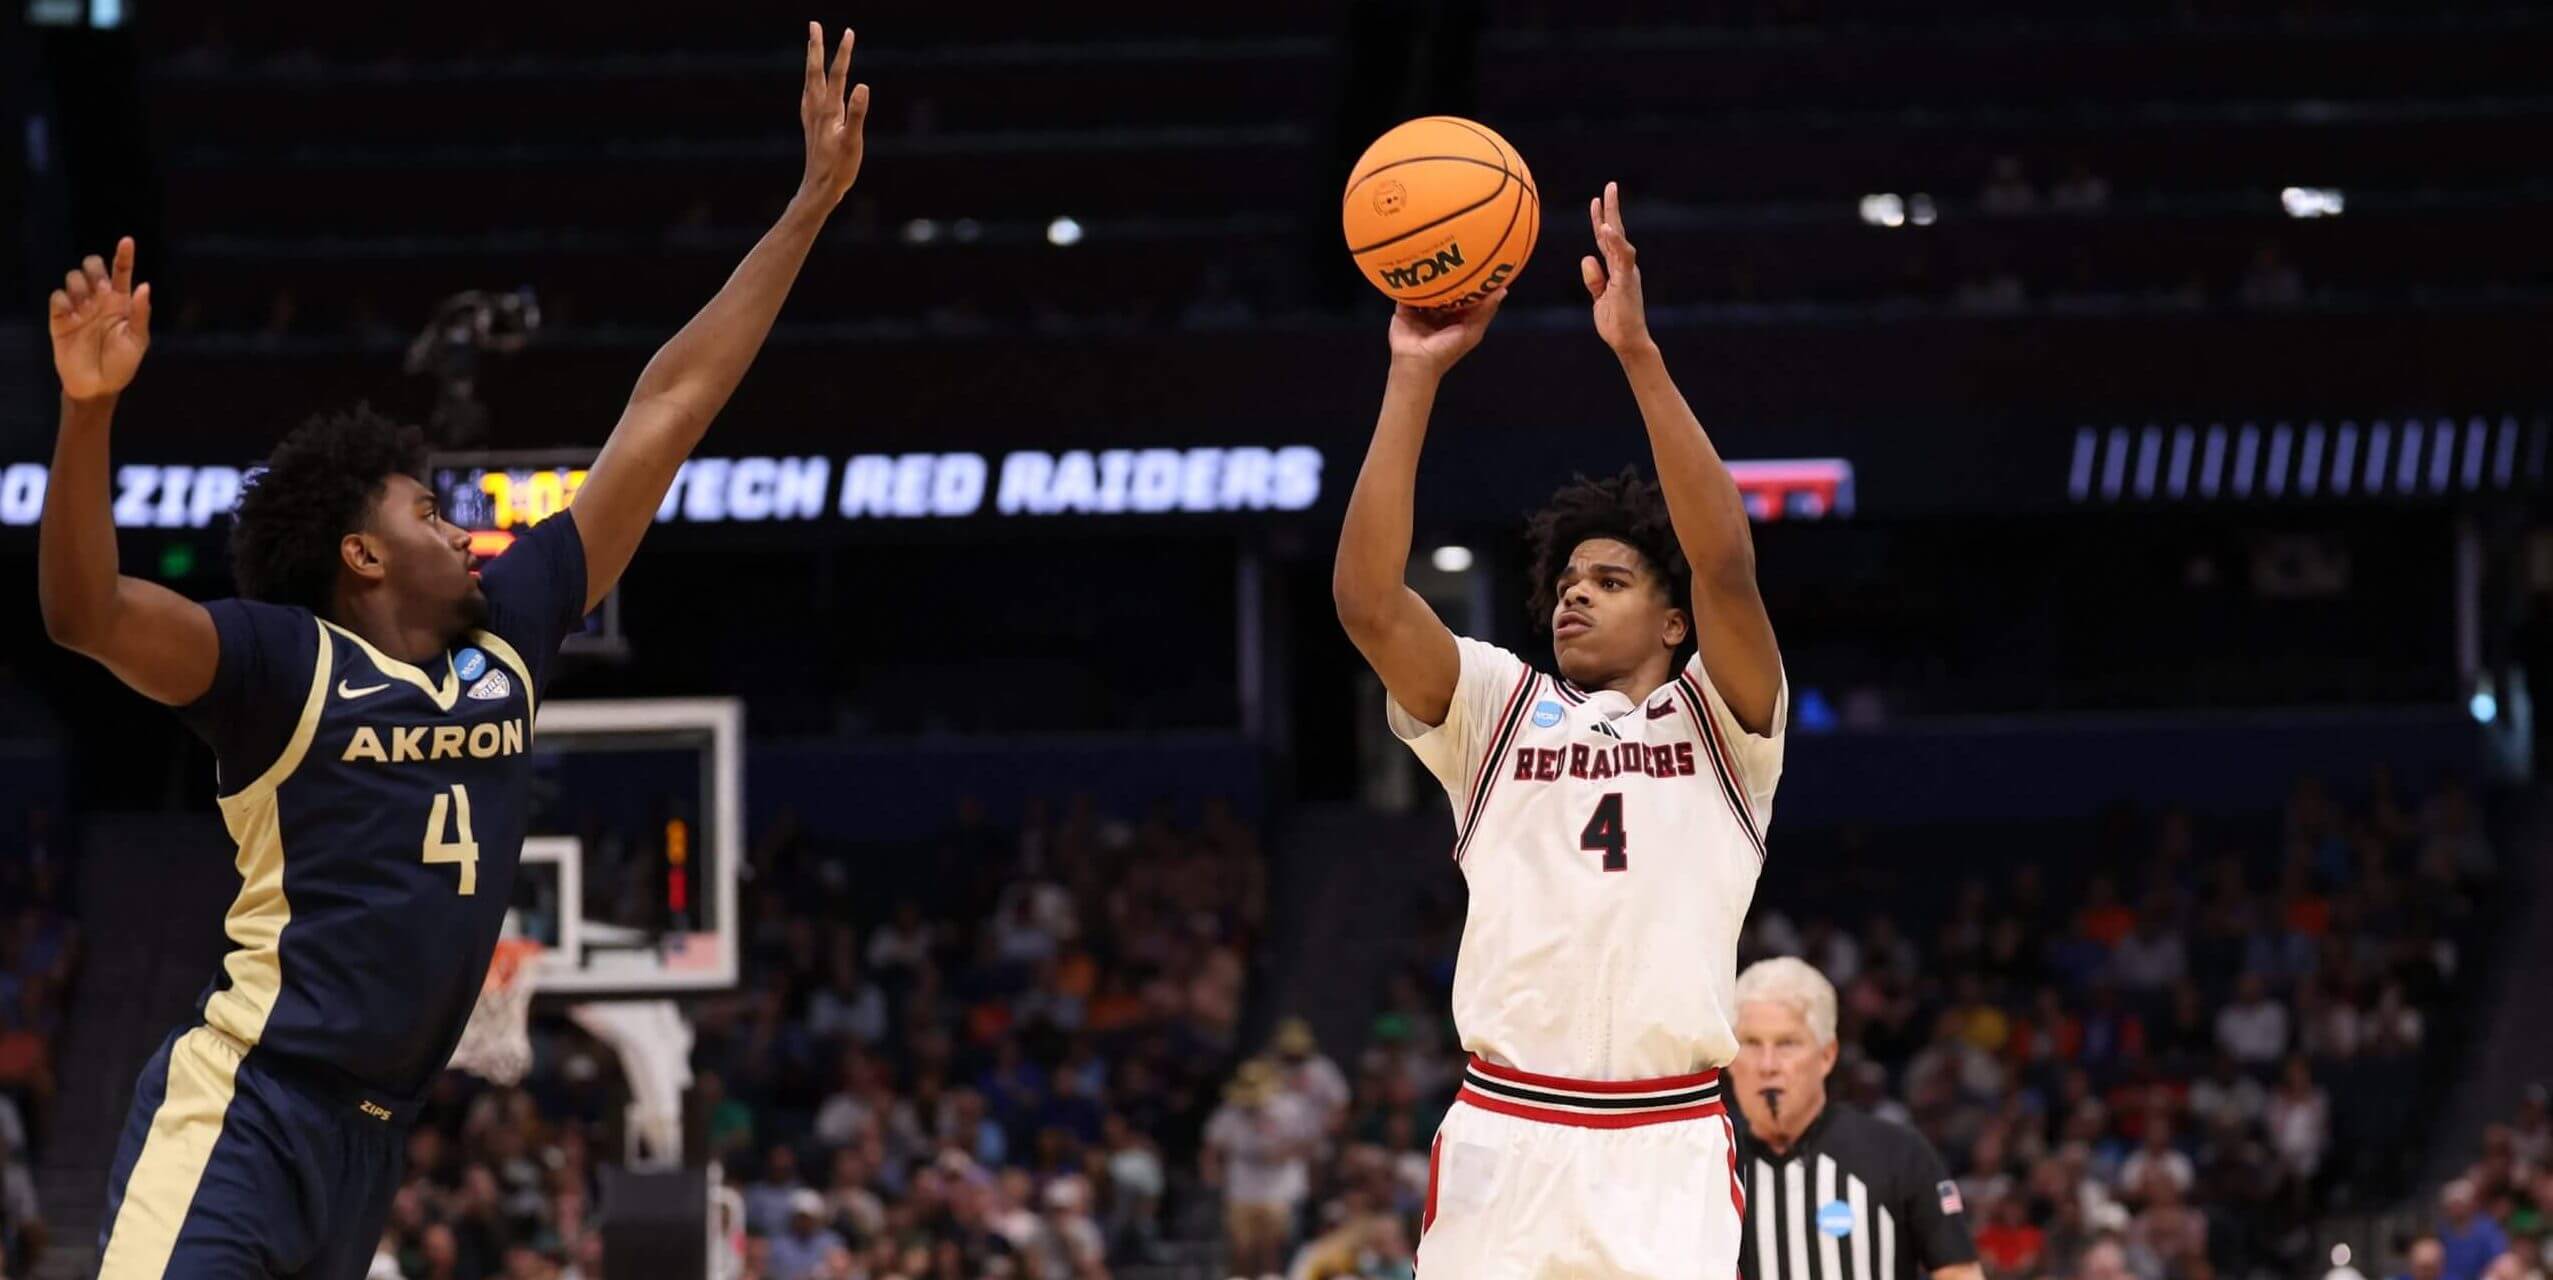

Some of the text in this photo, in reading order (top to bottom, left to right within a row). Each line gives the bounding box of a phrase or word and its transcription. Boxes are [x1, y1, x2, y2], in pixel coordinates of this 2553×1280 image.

[1379, 243, 1465, 289] NCAA
[113, 464, 255, 528] ZIP
[839, 451, 988, 519] RED
[997, 445, 1324, 515] RAIDERS
[341, 718, 523, 763] AKRON
[1513, 741, 1696, 782] RED RAIDERS
[422, 784, 479, 895] 4
[1580, 792, 1628, 872] 4
[360, 1100, 392, 1120] ZIPS
